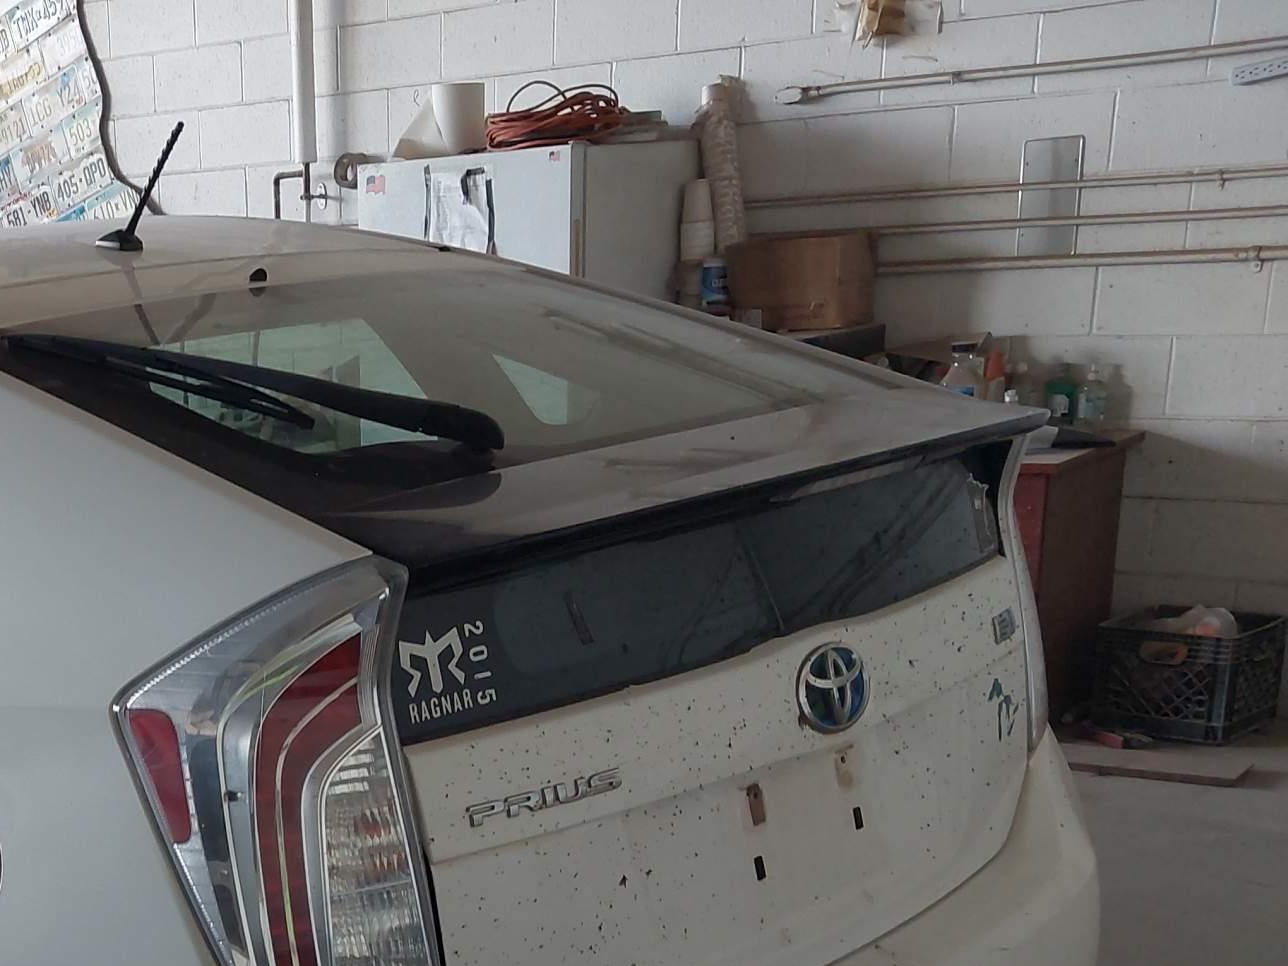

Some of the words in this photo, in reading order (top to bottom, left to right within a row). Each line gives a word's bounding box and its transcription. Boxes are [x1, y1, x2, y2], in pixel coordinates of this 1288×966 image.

[464, 620, 497, 705] 2015
[409, 689, 473, 724] RAGNAR
[466, 767, 623, 828] PRIUS
